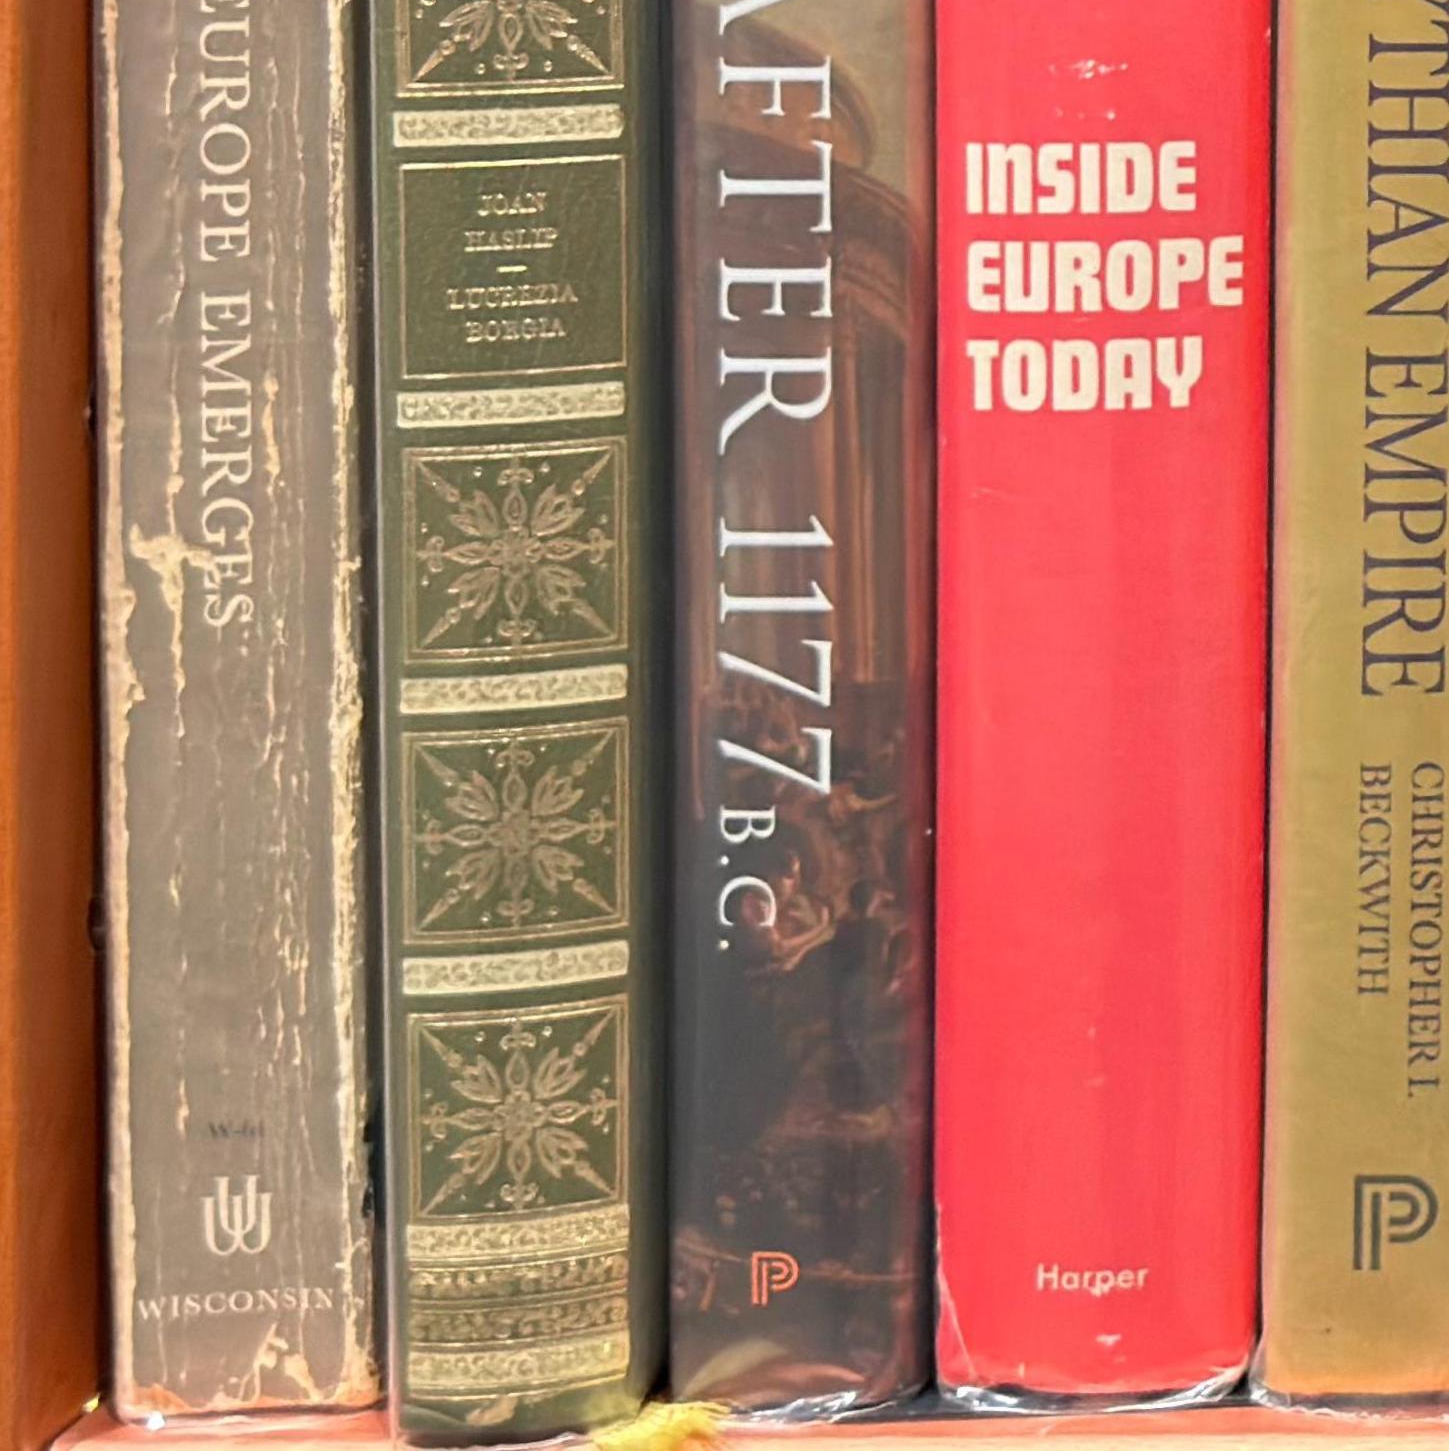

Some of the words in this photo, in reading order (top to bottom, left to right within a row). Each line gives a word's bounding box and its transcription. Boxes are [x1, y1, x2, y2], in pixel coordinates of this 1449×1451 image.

[477, 191, 548, 217] JOAN
[965, 140, 1197, 215] INSIDE
[464, 227, 559, 252] HASLIP
[965, 234, 1245, 313] EUROPE
[446, 284, 579, 310] LUCREZIA
[465, 318, 568, 343] BORGIA
[965, 335, 1204, 412] TODAY
[200, 290, 255, 628] EMERGES
[718, 515, 835, 795] 1177
[718, 804, 777, 952] B.C.
[1355, 762, 1394, 997] BECKWITH
[1409, 762, 1446, 1065] CHRISTOPHER
[137, 1287, 334, 1321] WISCONSIN
[1037, 1262, 1149, 1297] Harper
